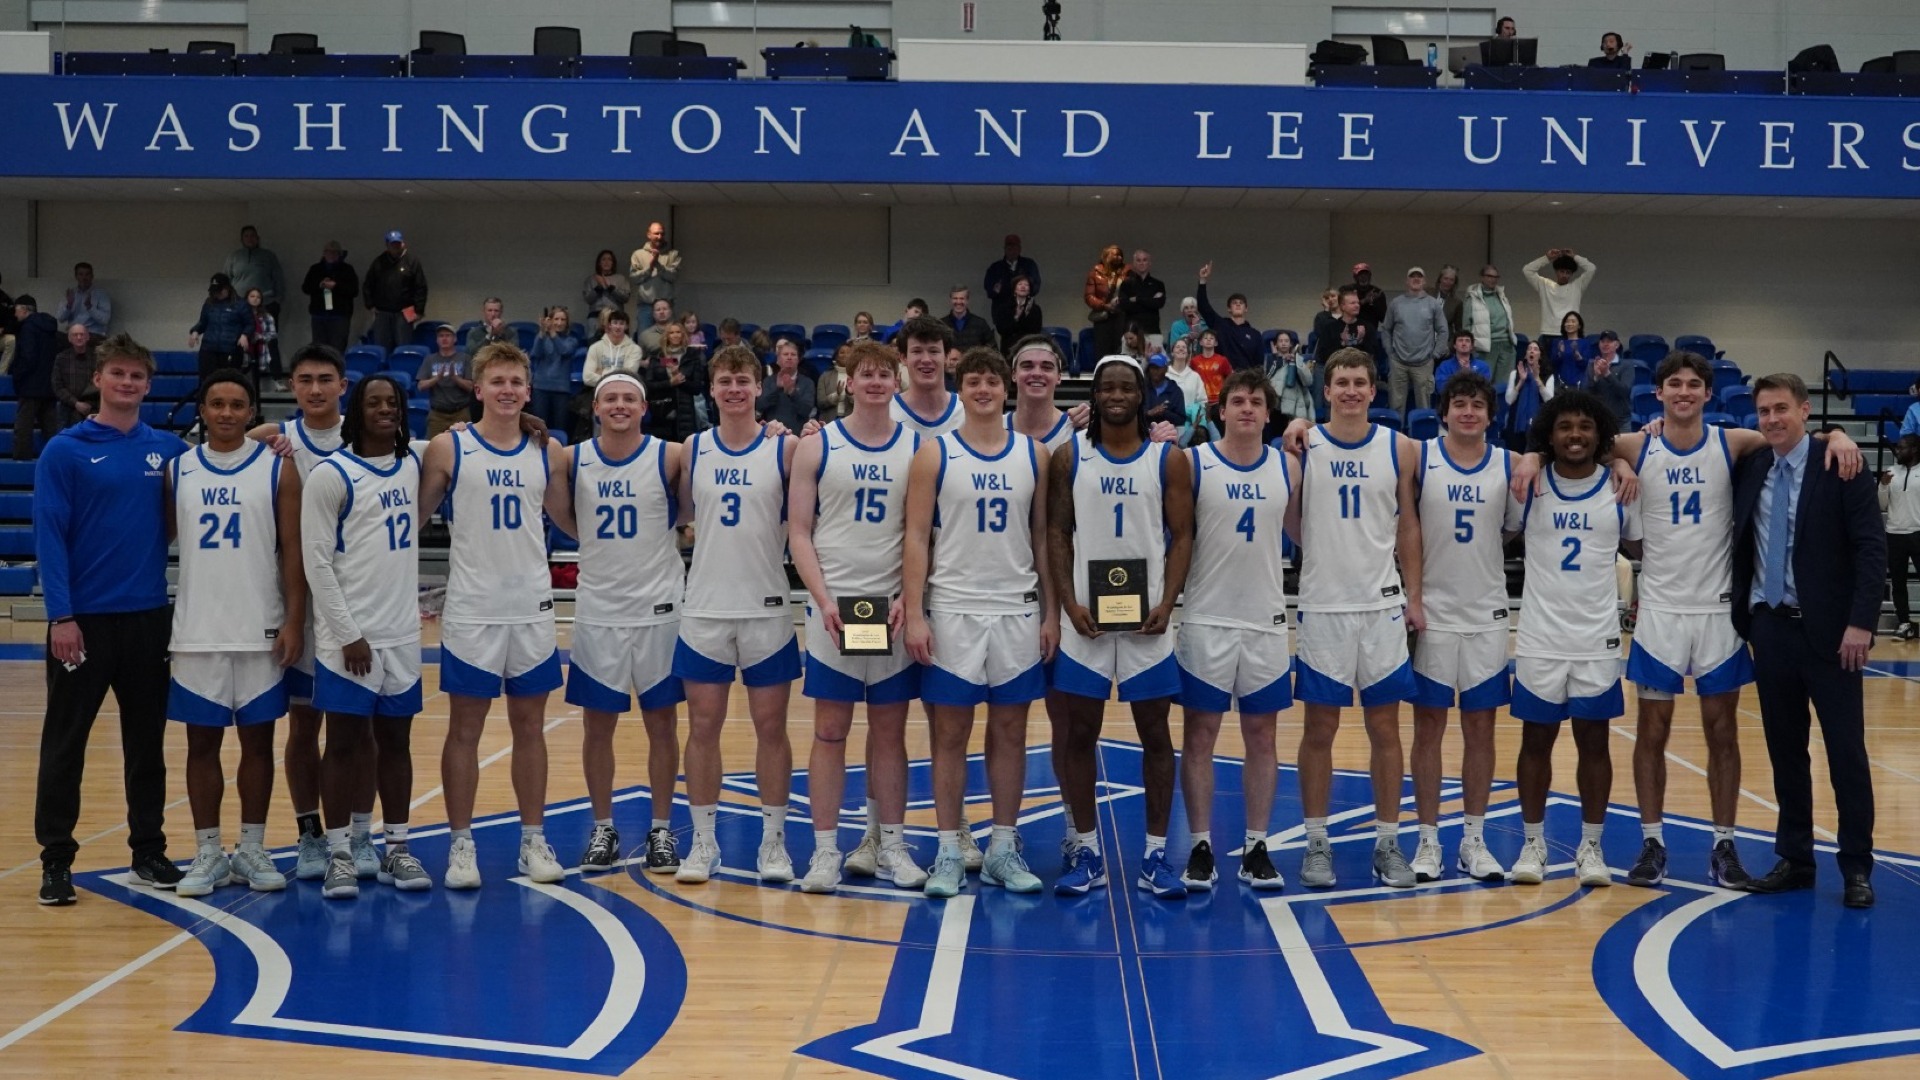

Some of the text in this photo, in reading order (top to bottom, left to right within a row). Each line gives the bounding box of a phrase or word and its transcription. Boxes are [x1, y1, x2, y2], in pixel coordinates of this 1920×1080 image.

[53, 102, 1920, 171] WASHINGTON AND LEE UNIVERS
[486, 468, 526, 489] W&L
[714, 468, 753, 487] W&L
[852, 464, 894, 483] W&L
[971, 473, 1013, 492] W&L
[1330, 461, 1370, 478] W&L
[1666, 466, 1706, 485] W&L
[201, 487, 241, 506] W&L
[379, 489, 412, 509] W&L
[597, 480, 637, 499] W&L
[1100, 477, 1139, 497] W&L
[1226, 483, 1266, 501] W&L
[1339, 484, 1360, 518] 11
[1447, 485, 1486, 503] W&L
[491, 494, 522, 530] 10
[596, 504, 638, 539] 20
[721, 492, 741, 527] 3
[855, 488, 888, 523] 15
[977, 497, 1008, 532] 13
[1114, 503, 1123, 537] 1
[1552, 511, 1593, 530] W&L
[1670, 490, 1701, 524] 14
[199, 512, 241, 549] 24
[385, 512, 412, 550] 12
[1236, 507, 1255, 542] 4
[1455, 509, 1474, 543] 5
[1560, 536, 1581, 571] 2
